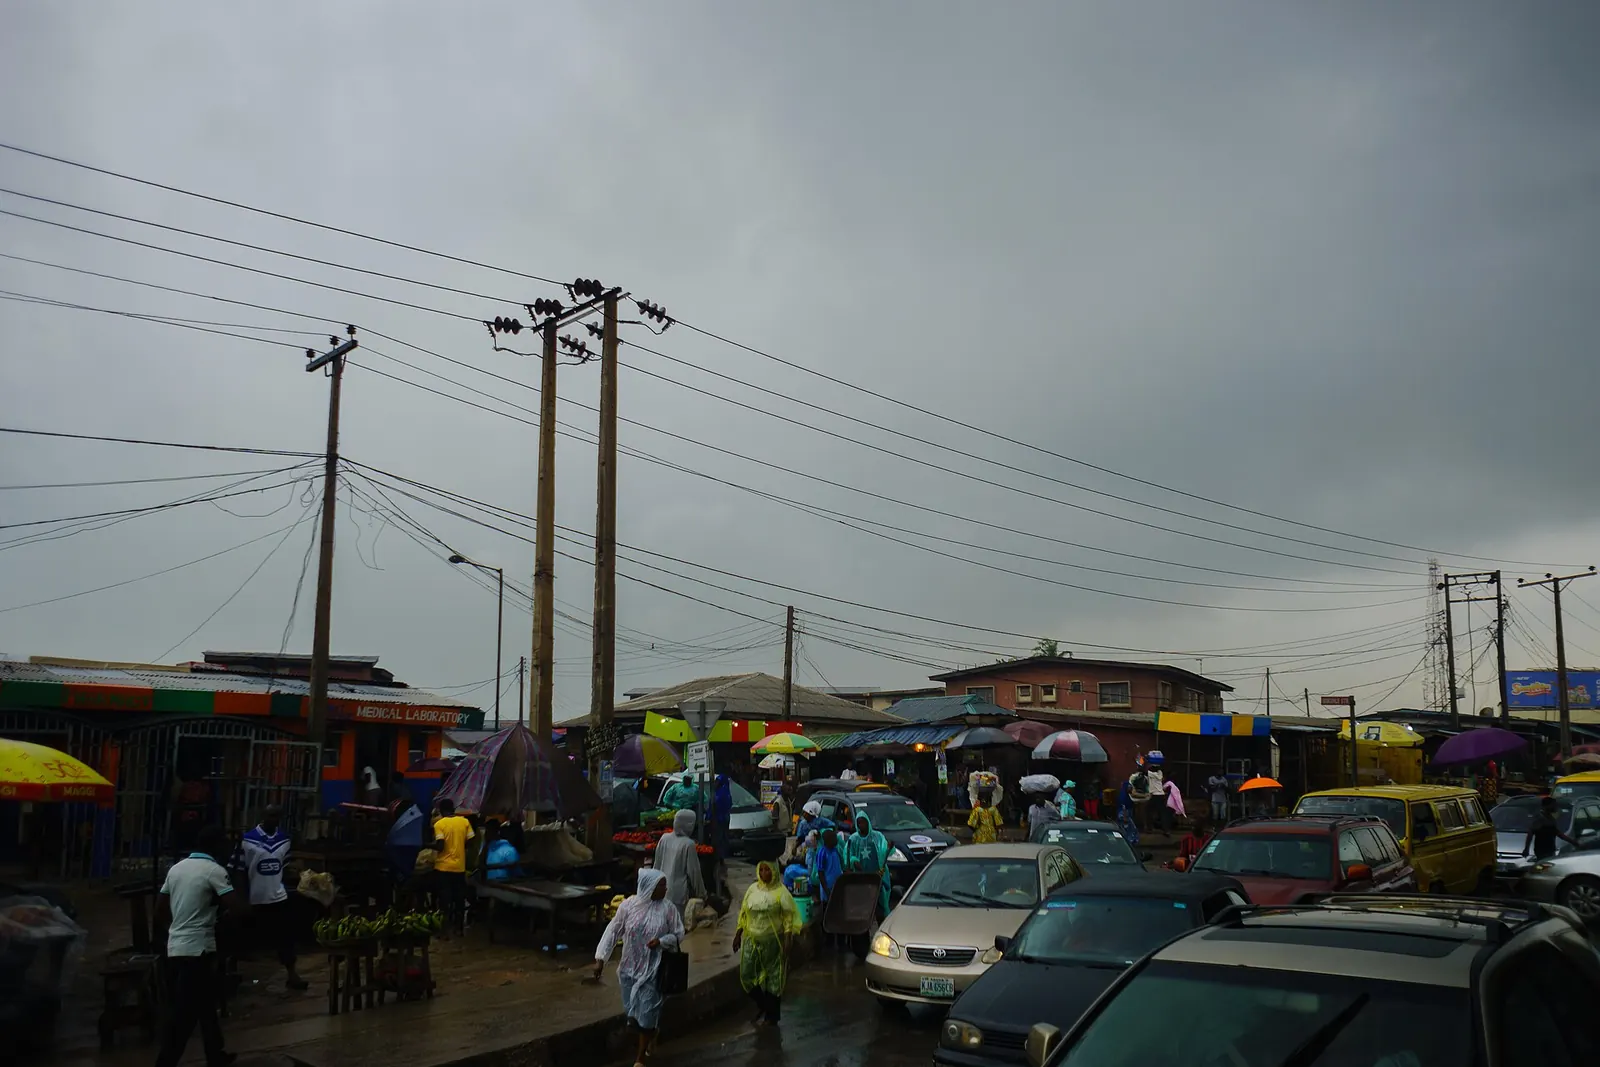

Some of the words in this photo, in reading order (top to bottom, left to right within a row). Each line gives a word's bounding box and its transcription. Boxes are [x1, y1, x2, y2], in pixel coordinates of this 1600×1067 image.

[356, 705, 402, 720] MEDICAL
[405, 708, 471, 725] LABORATORY
[63, 786, 97, 797] MAGGI
